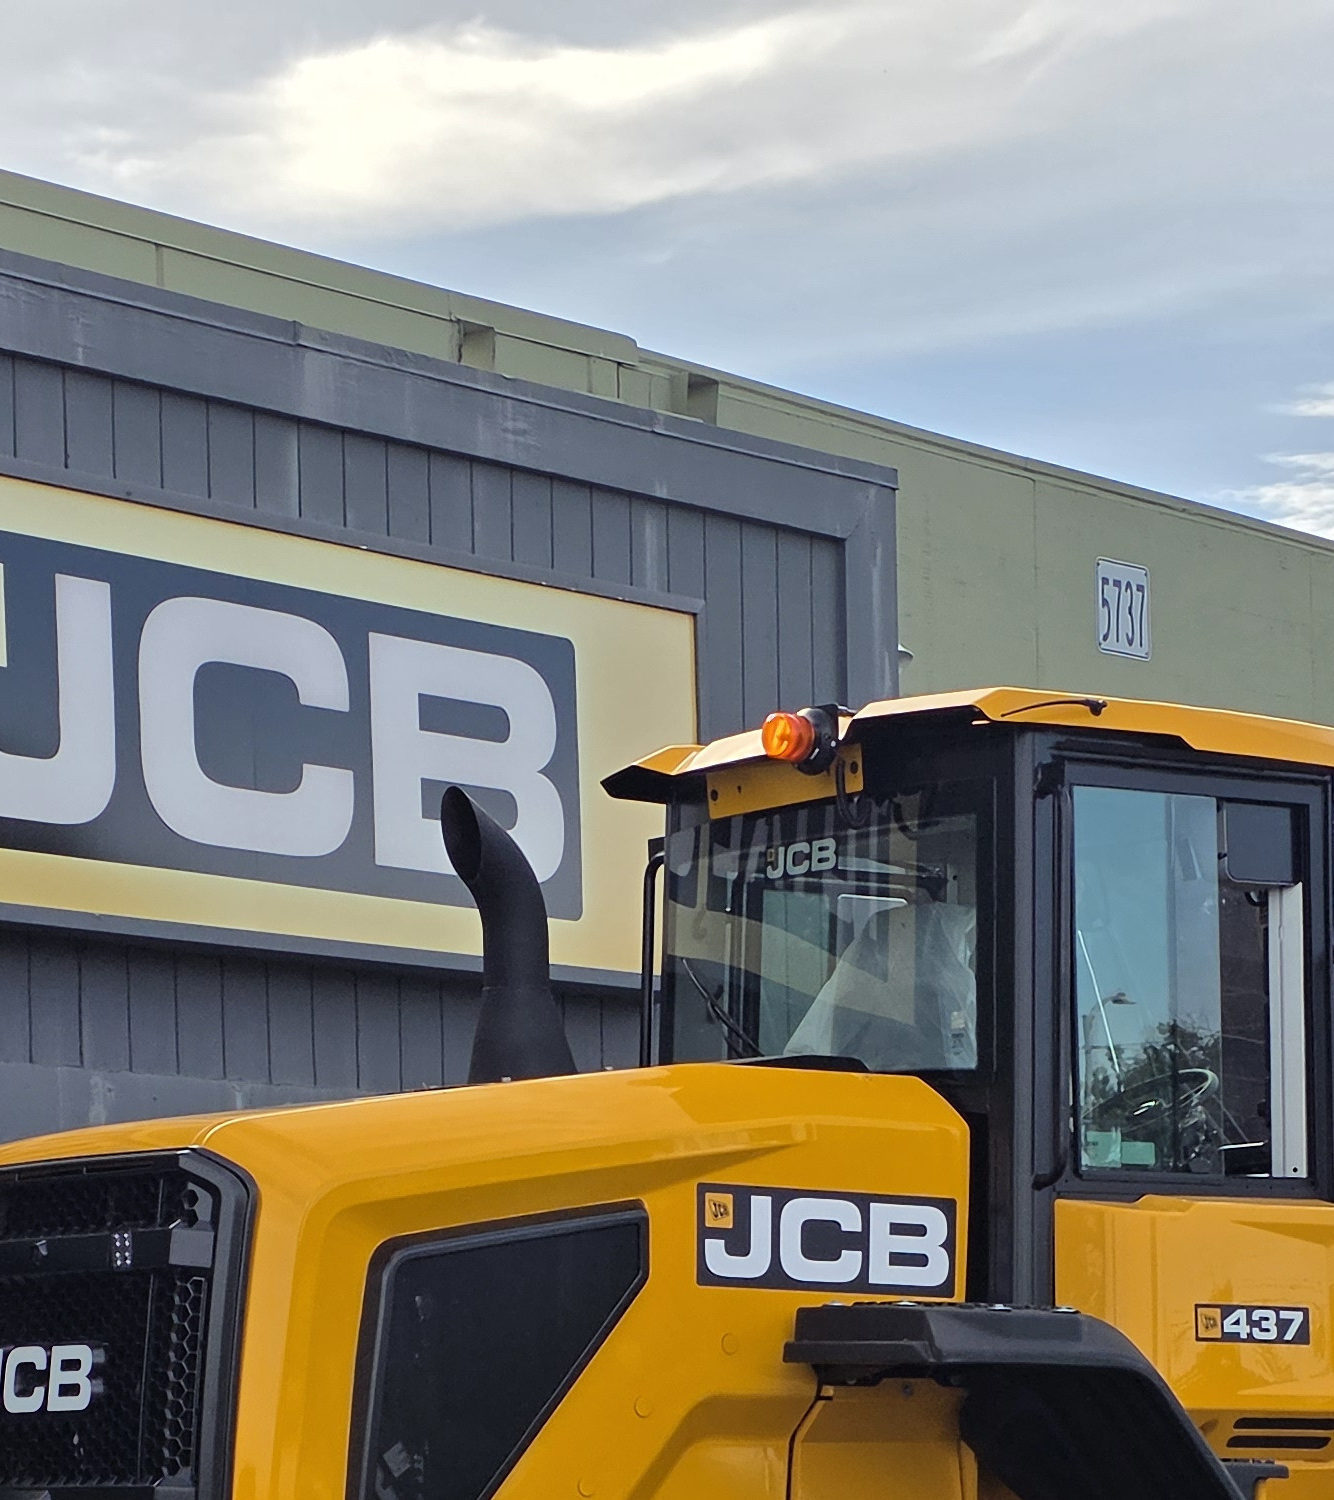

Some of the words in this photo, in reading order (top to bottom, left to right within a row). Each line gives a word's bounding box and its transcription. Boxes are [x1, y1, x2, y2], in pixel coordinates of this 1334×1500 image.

[1101, 576, 1145, 648] 5737
[767, 838, 837, 879] JCB
[704, 1195, 950, 1287] JCB
[1223, 1308, 1304, 1341] 437
